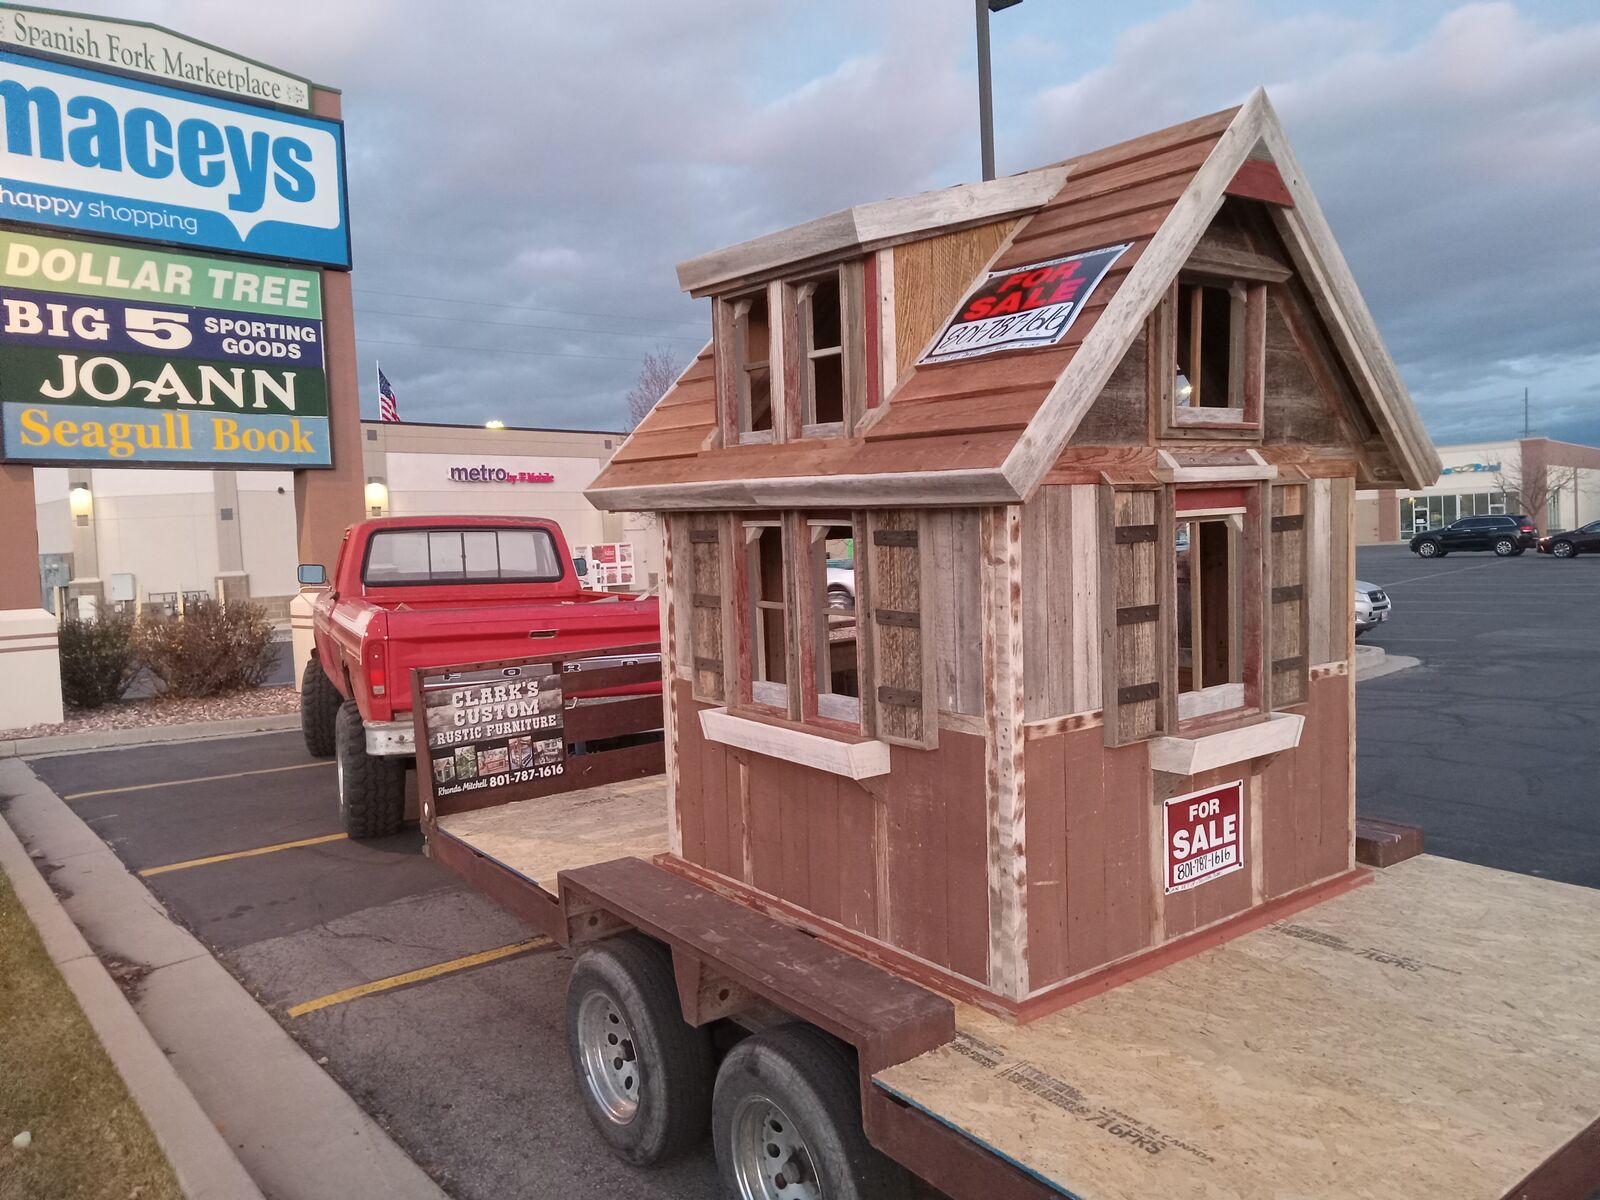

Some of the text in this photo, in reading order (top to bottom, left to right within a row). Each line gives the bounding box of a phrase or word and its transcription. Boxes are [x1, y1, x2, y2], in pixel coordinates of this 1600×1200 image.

[14, 12, 281, 100] Spanish Fork Marketplace
[0, 79, 316, 213] maceys
[0, 184, 198, 235] happy shopping
[5, 243, 311, 309] DOLLAR TREE
[997, 261, 1083, 293] FOR
[963, 277, 1087, 320] SALE
[4, 299, 193, 350] BIG 5
[204, 317, 317, 342] SPORTING
[222, 337, 302, 359] GOODS
[20, 408, 316, 458] Seagull Book
[450, 464, 506, 481] metro
[452, 681, 539, 708] CLARK'S
[454, 699, 540, 726] CUSTOM
[437, 714, 557, 745] RUSTIC FURNITURE
[438, 764, 564, 796] Rhonda Mitchell 801-787-1616
[1189, 798, 1220, 822] FOR
[1172, 814, 1237, 860] SALE
[1177, 848, 1231, 880] 801-787-1616
